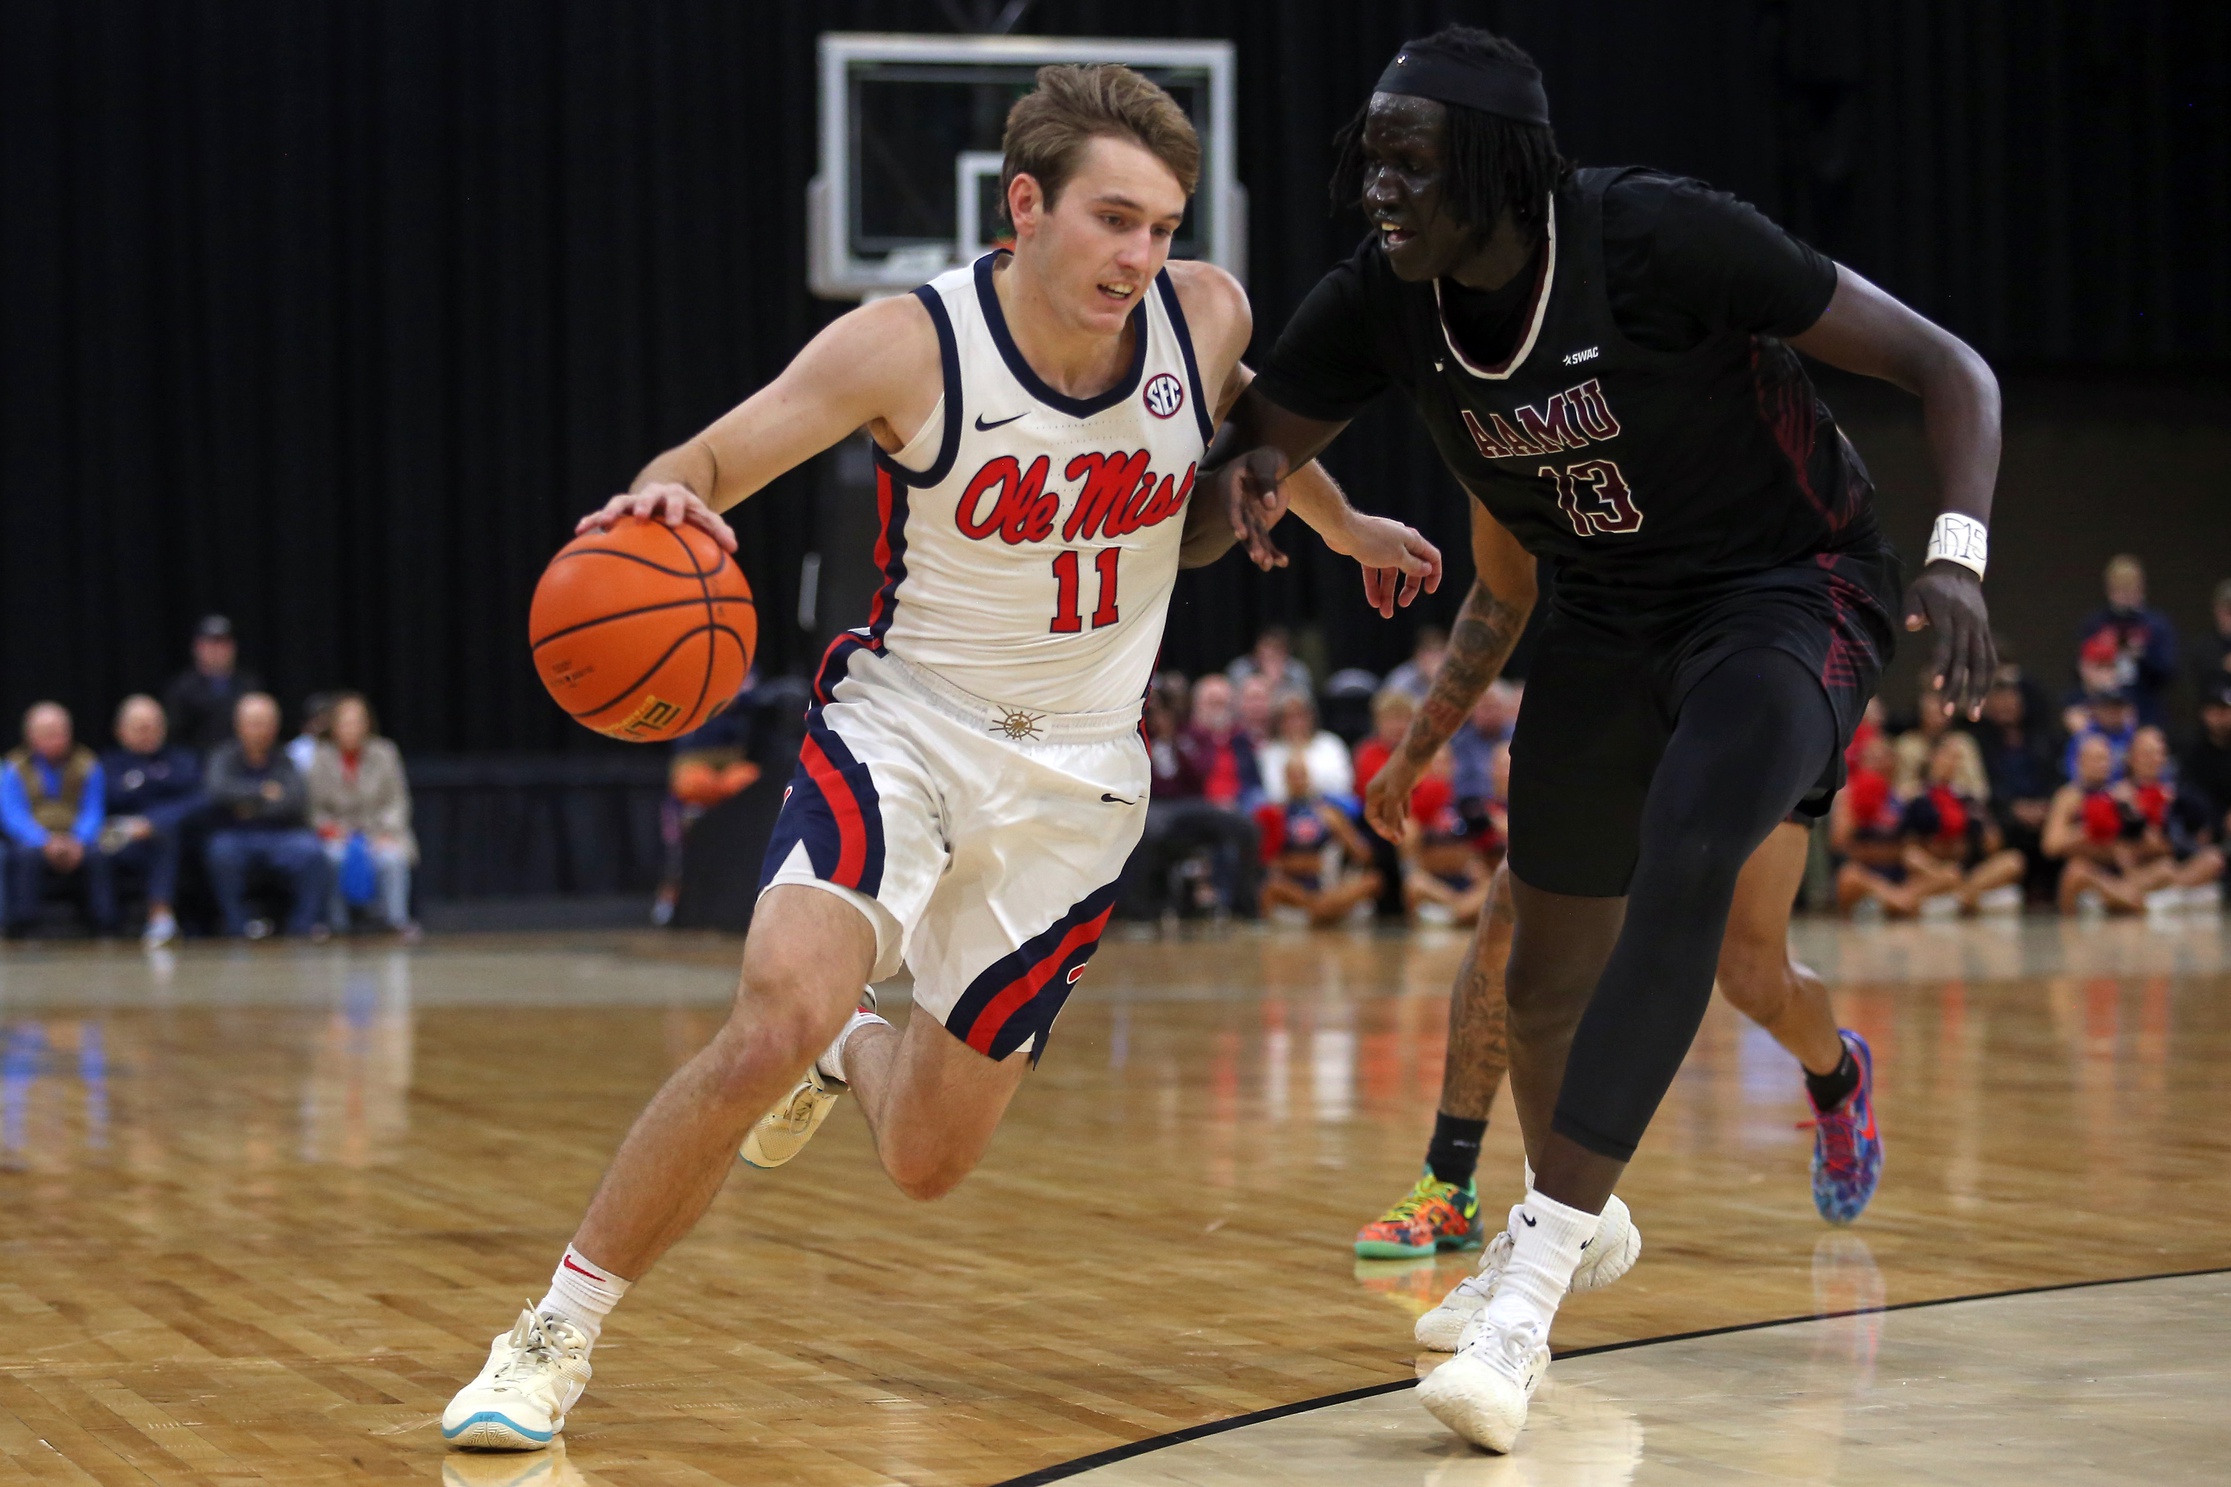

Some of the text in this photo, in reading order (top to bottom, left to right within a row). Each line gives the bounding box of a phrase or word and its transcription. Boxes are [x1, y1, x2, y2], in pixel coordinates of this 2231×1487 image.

[1572, 346, 1599, 365] SWAC
[1146, 376, 1181, 416] SEC
[1461, 378, 1621, 458] AAMU
[955, 455, 1060, 545] Ole
[1539, 459, 1643, 536] 13
[1050, 547, 1122, 634] 11
